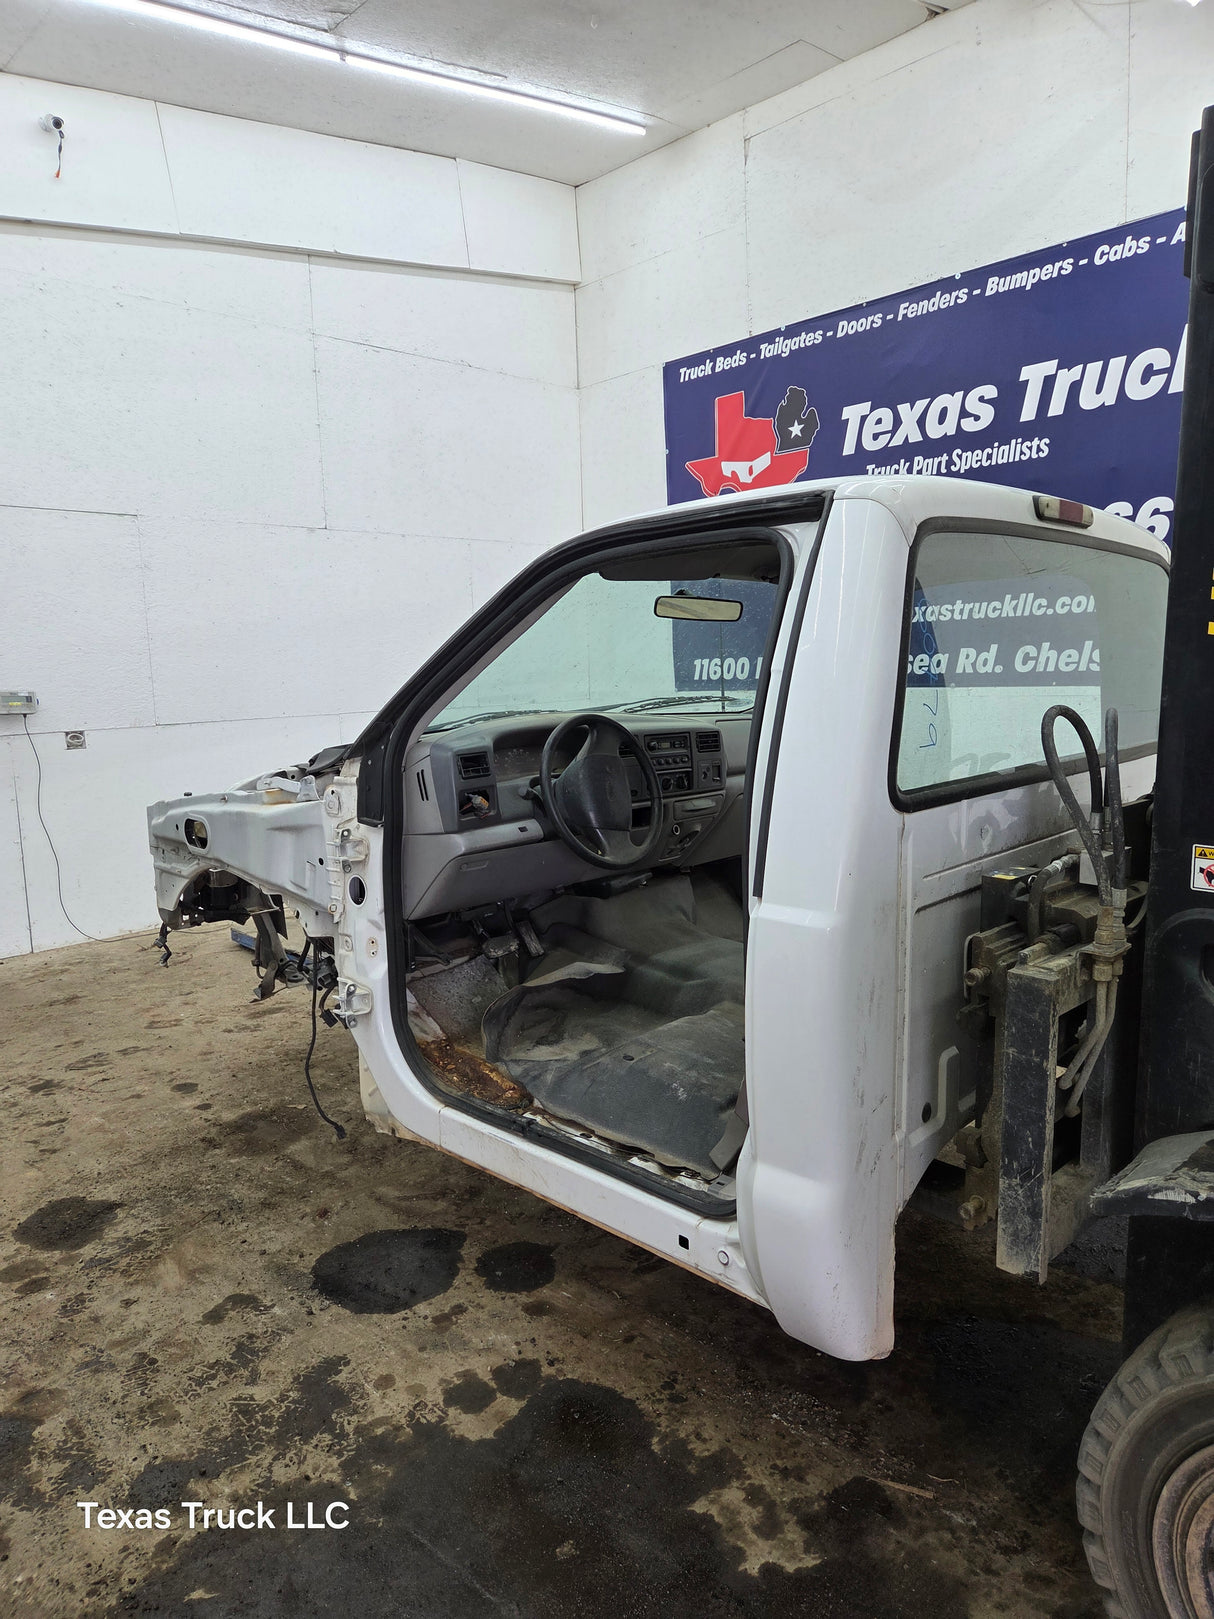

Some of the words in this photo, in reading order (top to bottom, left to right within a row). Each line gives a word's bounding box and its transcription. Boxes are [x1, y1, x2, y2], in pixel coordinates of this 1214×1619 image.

[679, 360, 713, 382] Truck
[715, 350, 747, 372] Beds
[760, 329, 822, 358] Tailgates
[837, 311, 882, 338] Doors
[897, 286, 968, 321] Fenders
[985, 257, 1074, 297] Bumpers
[1094, 235, 1151, 266] Cabs
[841, 384, 999, 456] Texas
[912, 453, 949, 476] Part
[950, 437, 1050, 473] Specialists
[693, 656, 750, 681] 11600
[956, 643, 1003, 674] Rd.
